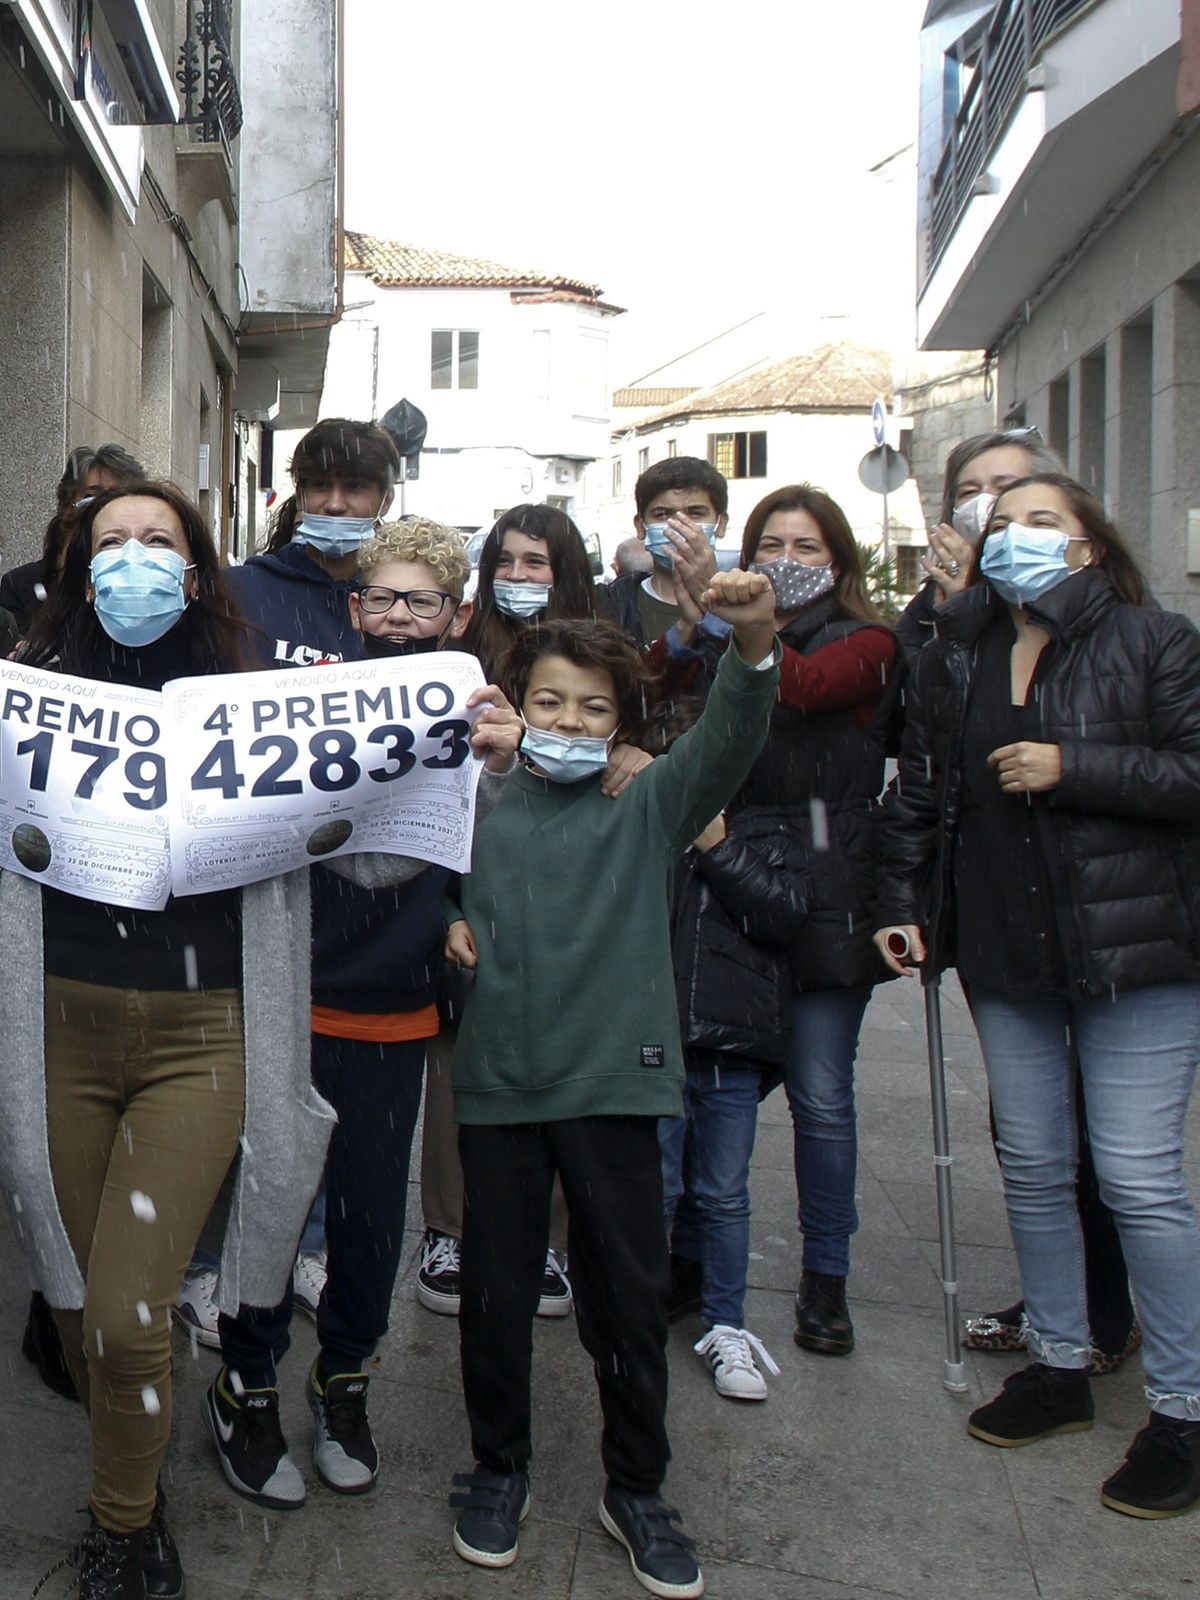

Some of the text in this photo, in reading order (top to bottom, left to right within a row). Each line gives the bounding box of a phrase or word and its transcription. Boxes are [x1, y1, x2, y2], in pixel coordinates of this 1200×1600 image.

[1, 667, 98, 698] VENDIDO AQUÍ
[274, 667, 377, 690] VENDIDO AQUÍ
[203, 681, 455, 736] 4º PREMIO
[190, 719, 471, 800] 42833
[393, 819, 436, 831] DICIEMBRE
[437, 825, 453, 835] 2021
[78, 859, 89, 867] DE
[90, 861, 134, 875] DICIEMBRE
[135, 869, 154, 879] 2021
[204, 856, 237, 867] LOTERÍA
